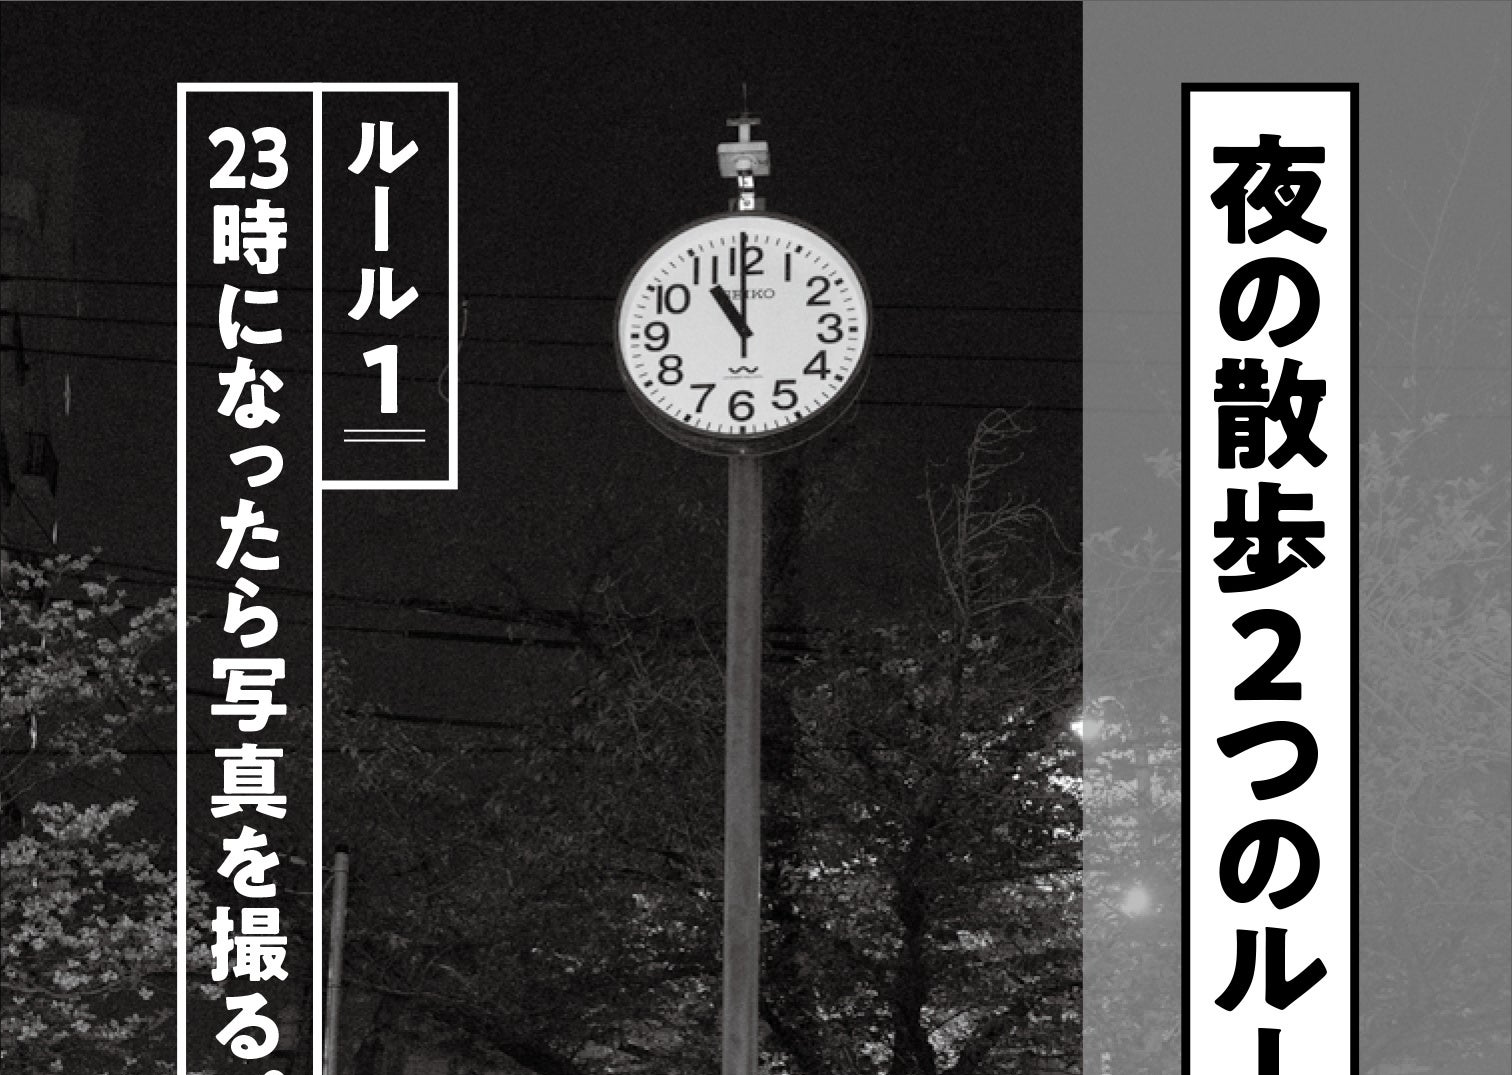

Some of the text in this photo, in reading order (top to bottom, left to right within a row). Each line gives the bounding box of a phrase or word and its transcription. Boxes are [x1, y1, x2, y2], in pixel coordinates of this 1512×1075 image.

[729, 246, 764, 277] 12
[656, 283, 691, 315] 10
[806, 275, 831, 307] 2
[644, 321, 670, 352] 9
[817, 313, 843, 344] 3
[657, 354, 684, 386] 8
[803, 349, 831, 381] 4
[690, 383, 716, 413] 7
[728, 389, 755, 422] 6
[771, 379, 799, 411] 5
